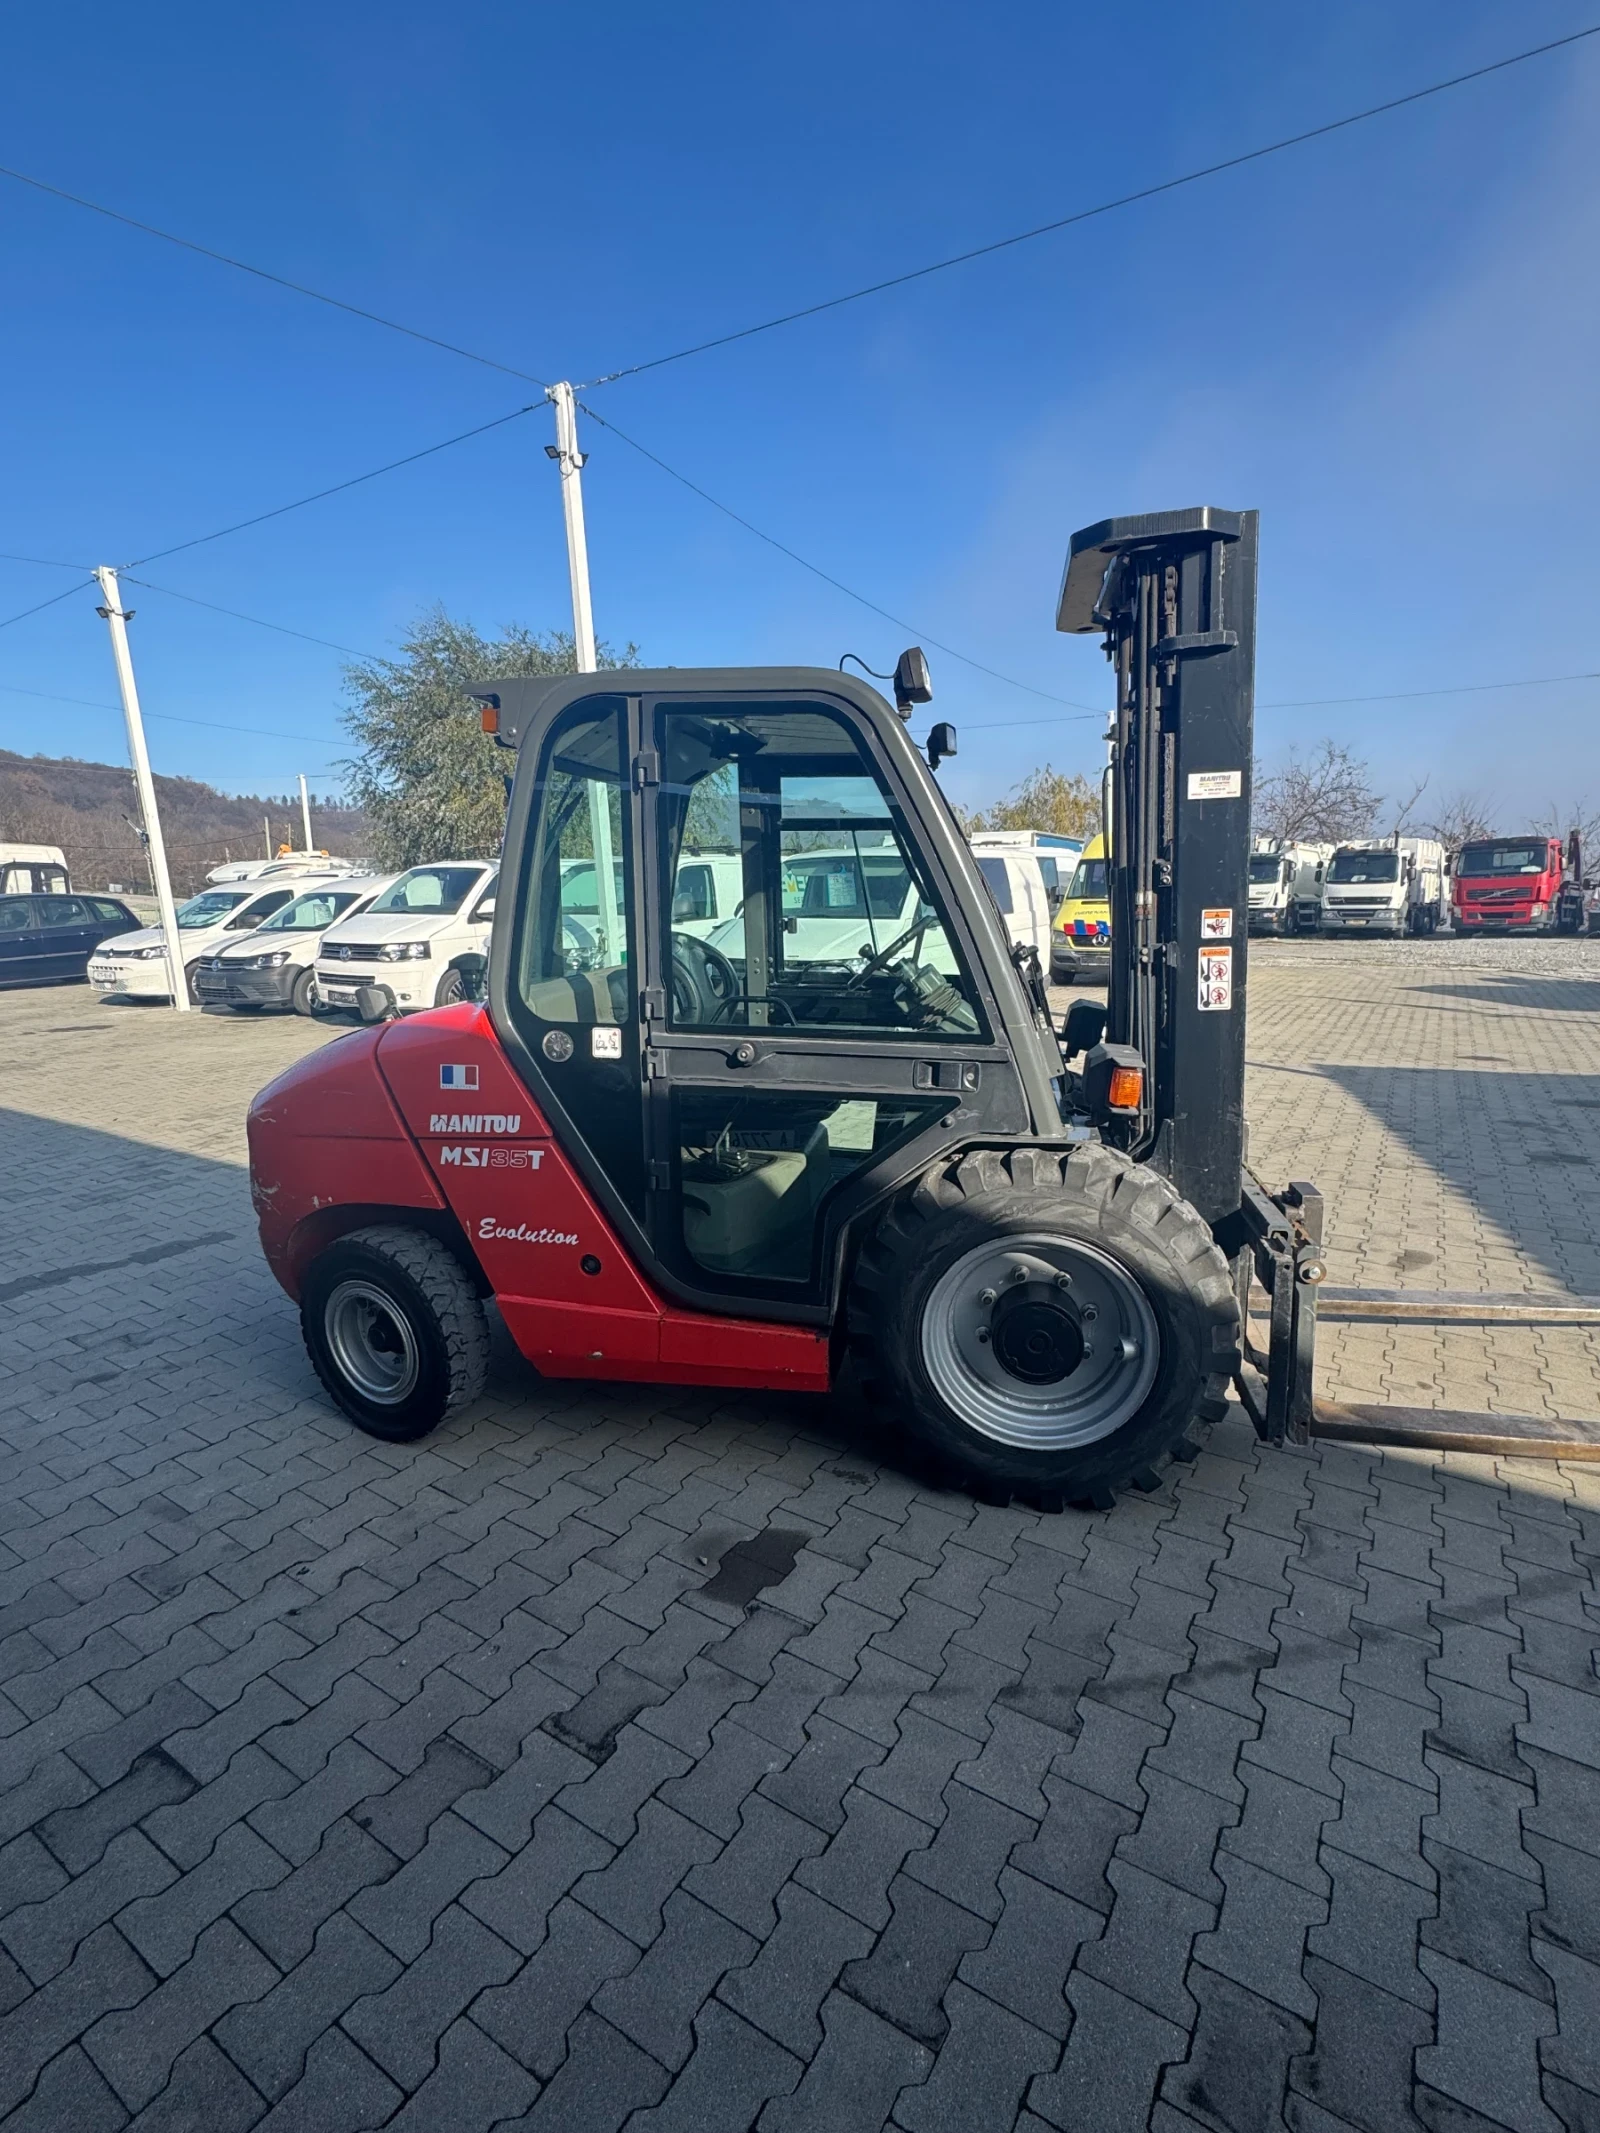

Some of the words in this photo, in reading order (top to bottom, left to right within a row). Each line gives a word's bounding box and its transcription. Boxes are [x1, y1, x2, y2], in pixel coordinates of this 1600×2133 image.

[429, 1114, 521, 1134] MANITOU
[440, 1146, 545, 1170] MSI35T
[478, 1217, 580, 1246] Evolution
